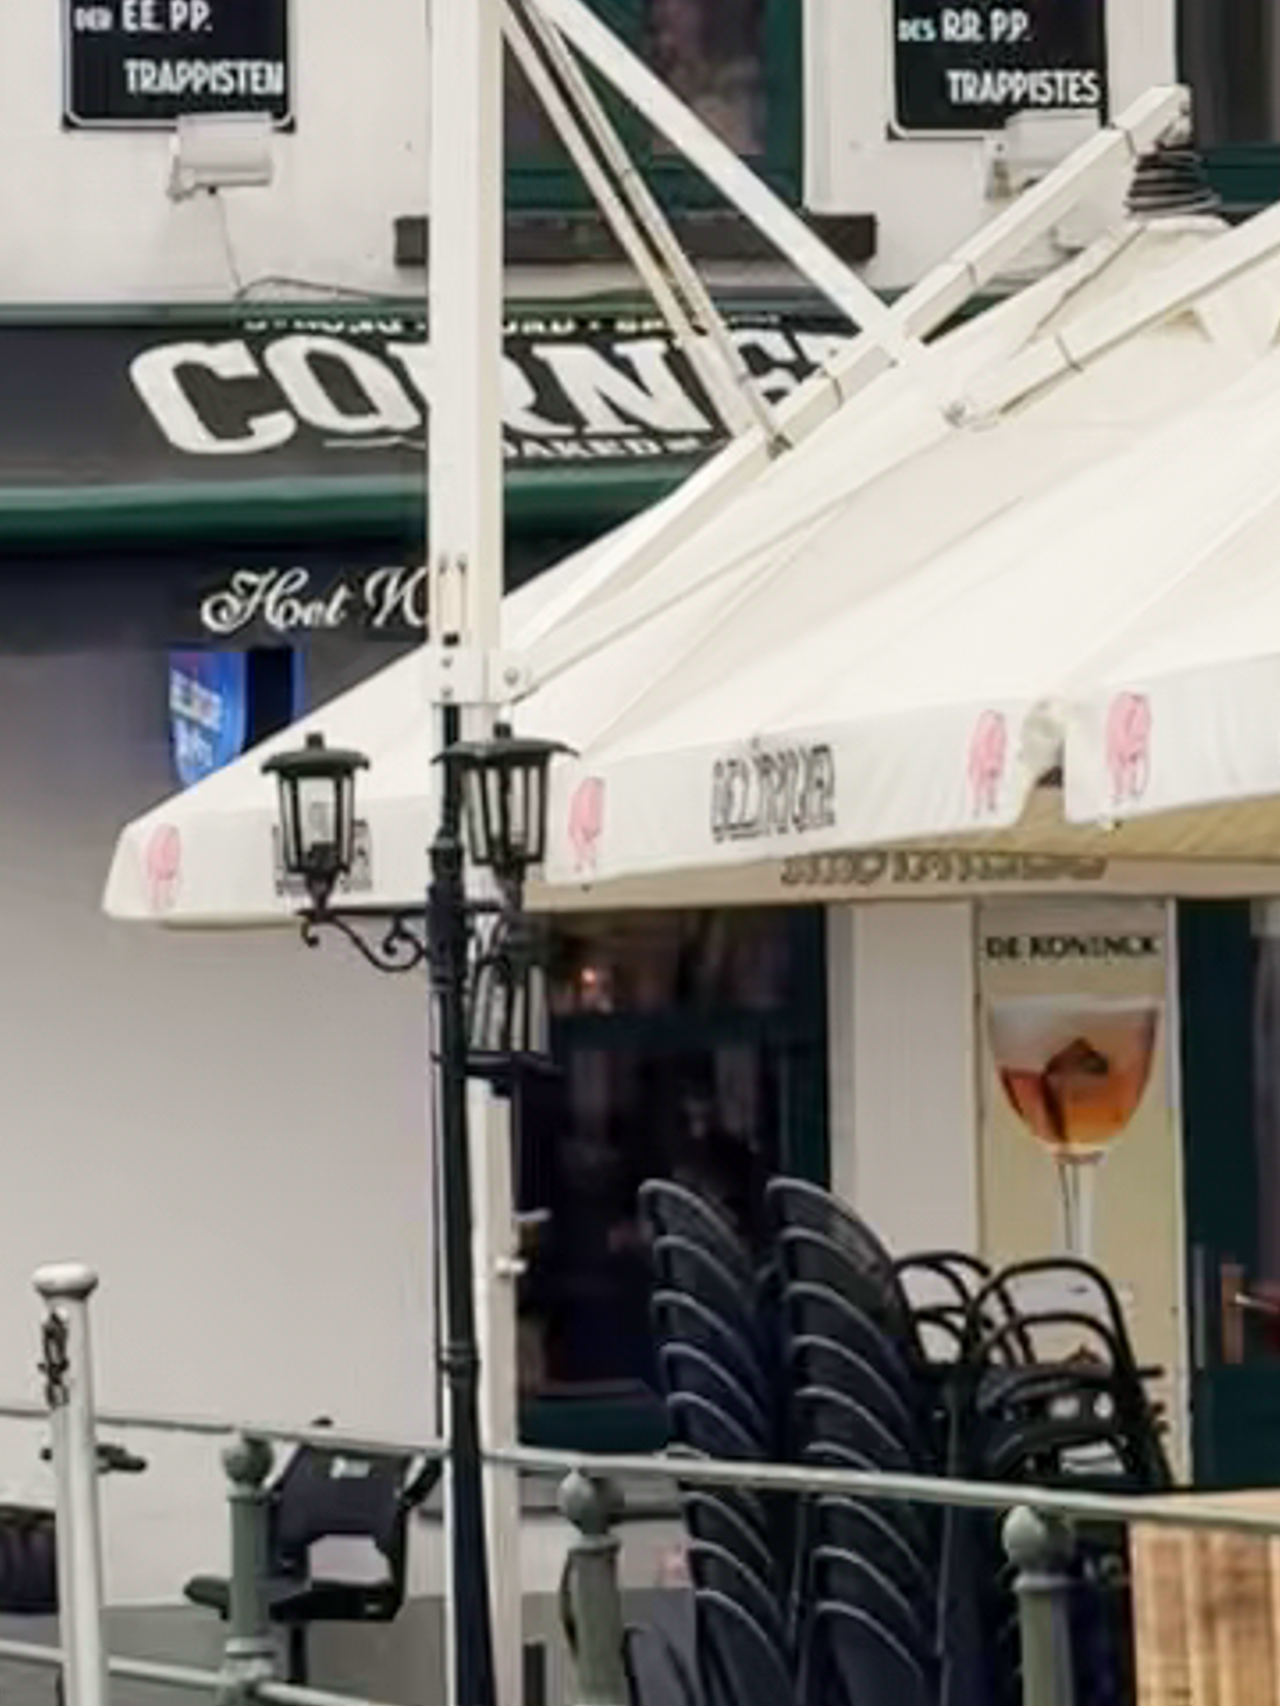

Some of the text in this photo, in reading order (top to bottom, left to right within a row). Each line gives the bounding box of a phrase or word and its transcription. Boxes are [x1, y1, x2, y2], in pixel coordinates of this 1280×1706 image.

[123, 58, 286, 96] TRAPPISTEN
[946, 68, 1103, 105] TRAPPISTES
[986, 936, 1020, 959] DE
